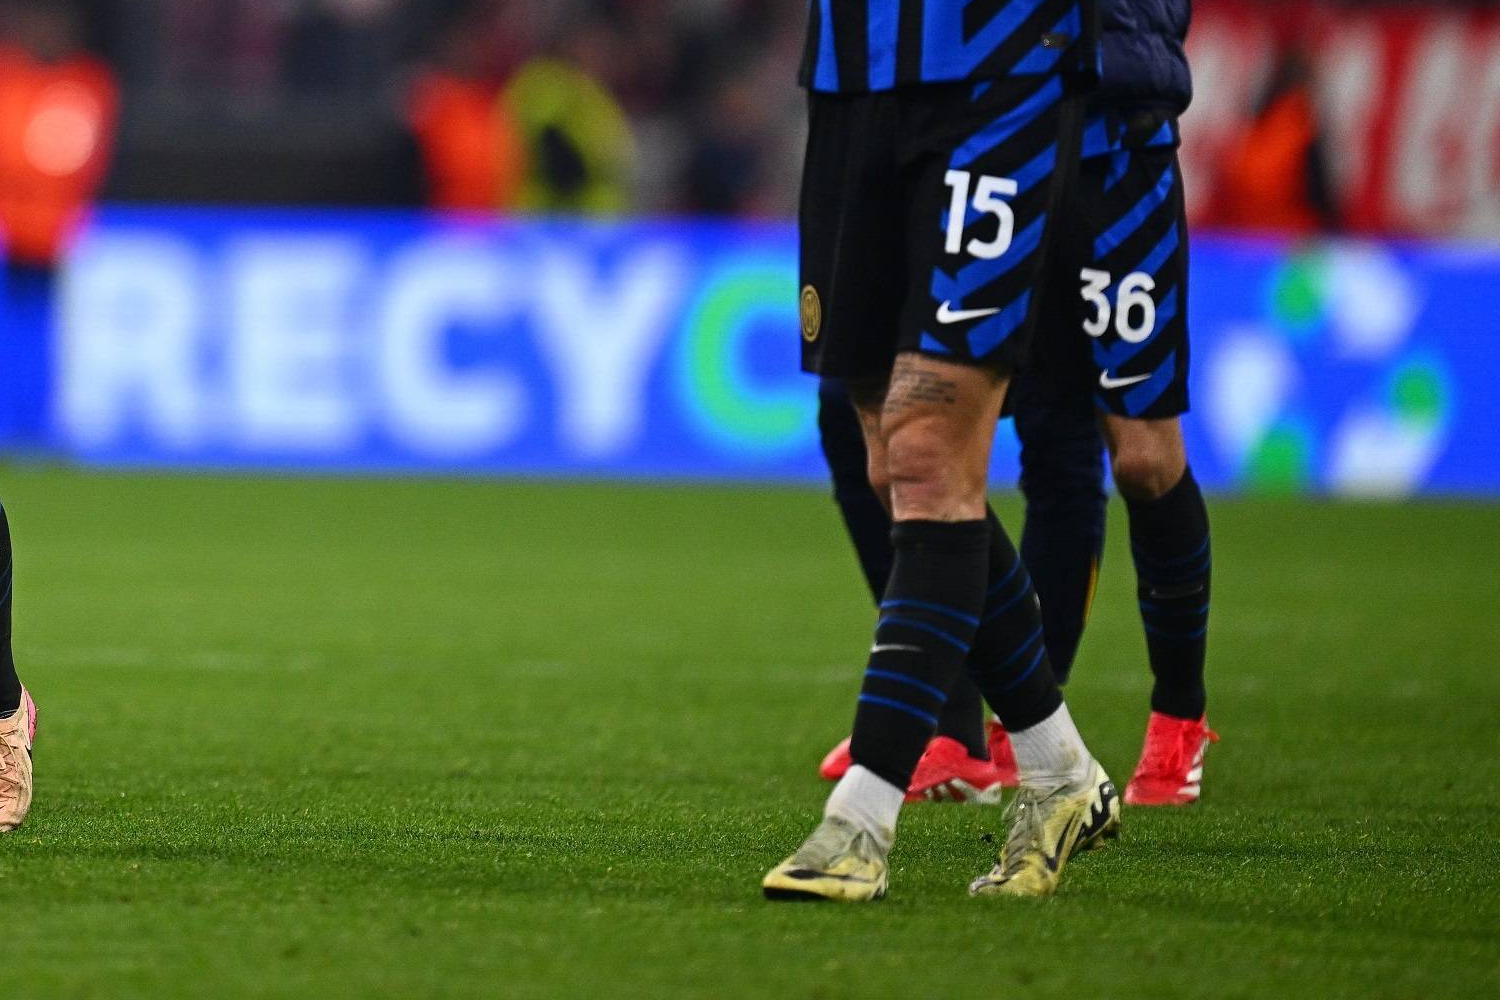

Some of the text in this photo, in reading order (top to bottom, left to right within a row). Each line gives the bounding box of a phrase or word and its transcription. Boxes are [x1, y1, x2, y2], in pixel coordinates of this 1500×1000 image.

[945, 170, 1017, 258] 15
[59, 230, 812, 457] RECYC
[1081, 269, 1156, 343] 36
